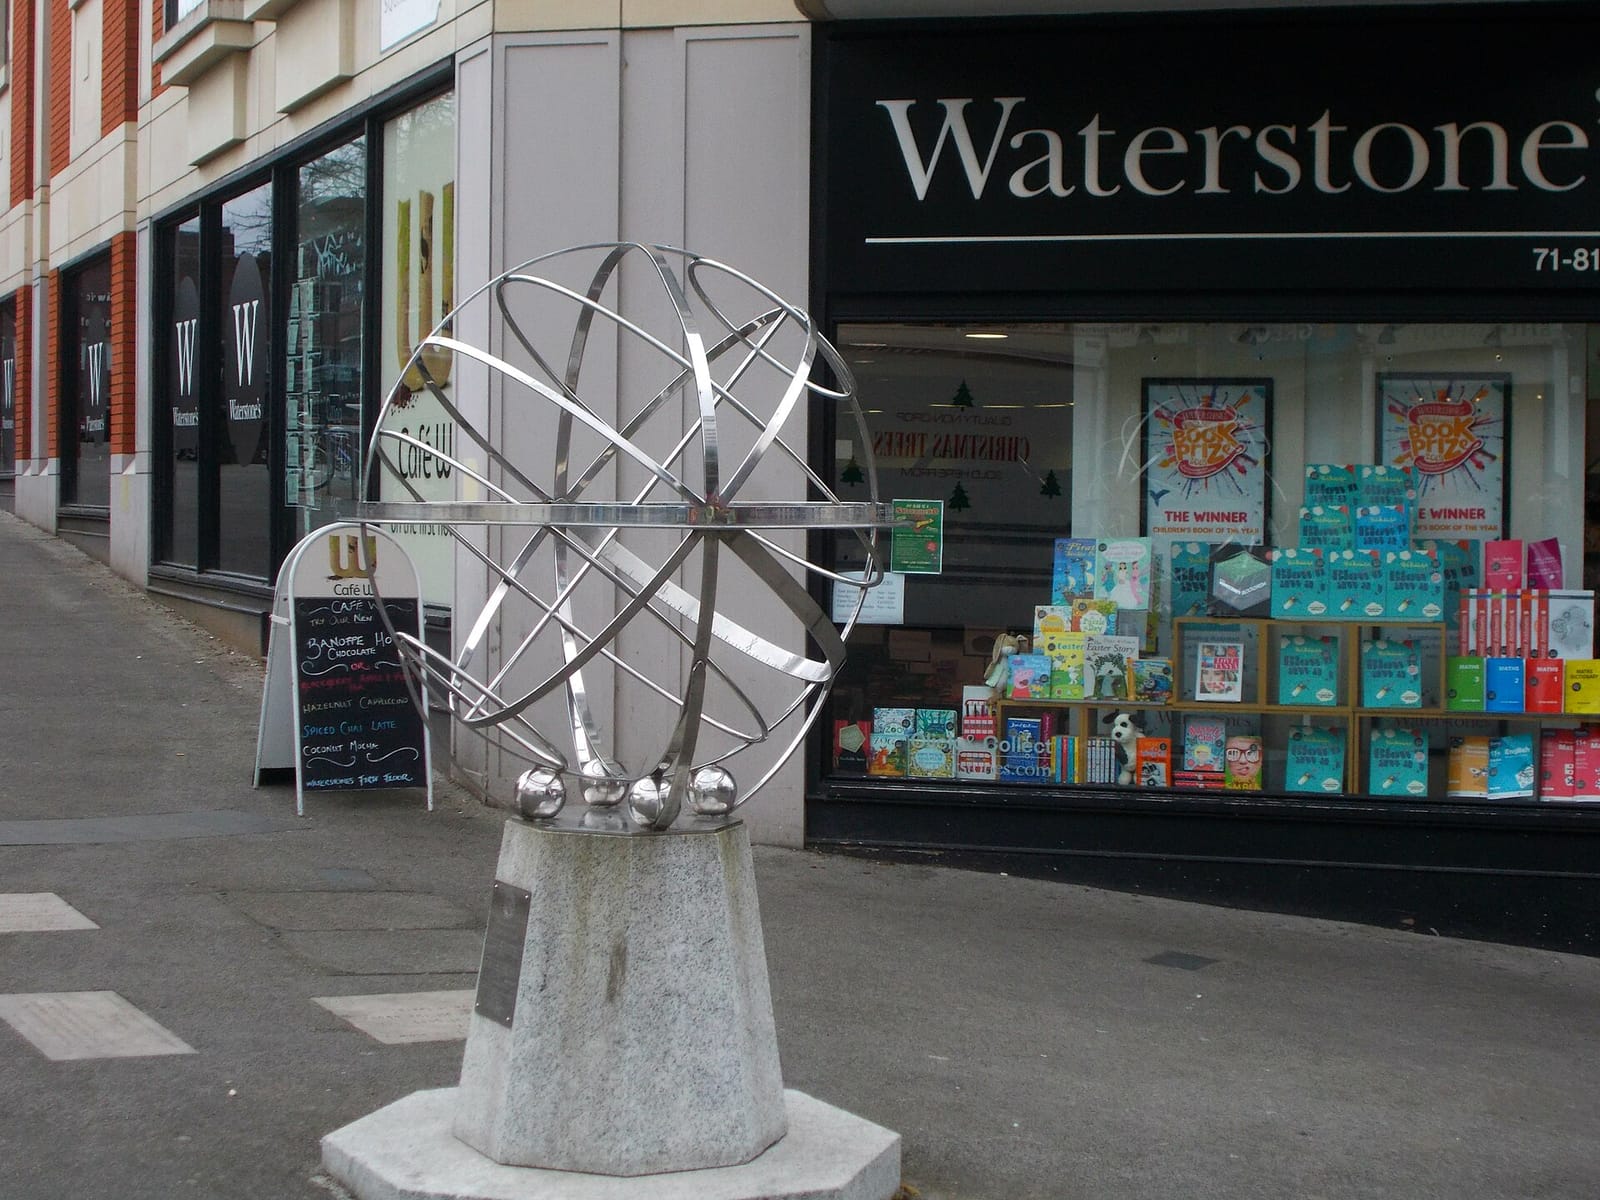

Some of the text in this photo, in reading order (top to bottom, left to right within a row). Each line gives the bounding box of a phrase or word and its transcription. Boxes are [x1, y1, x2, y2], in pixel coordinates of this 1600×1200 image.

[1532, 247, 1600, 273] 71-81
[232, 300, 259, 387] W
[176, 319, 197, 396] W
[1164, 510, 1248, 523] THE WINNER
[1430, 508, 1486, 520] WINNER
[334, 583, 360, 597] Café
[375, 631, 393, 647] HO
